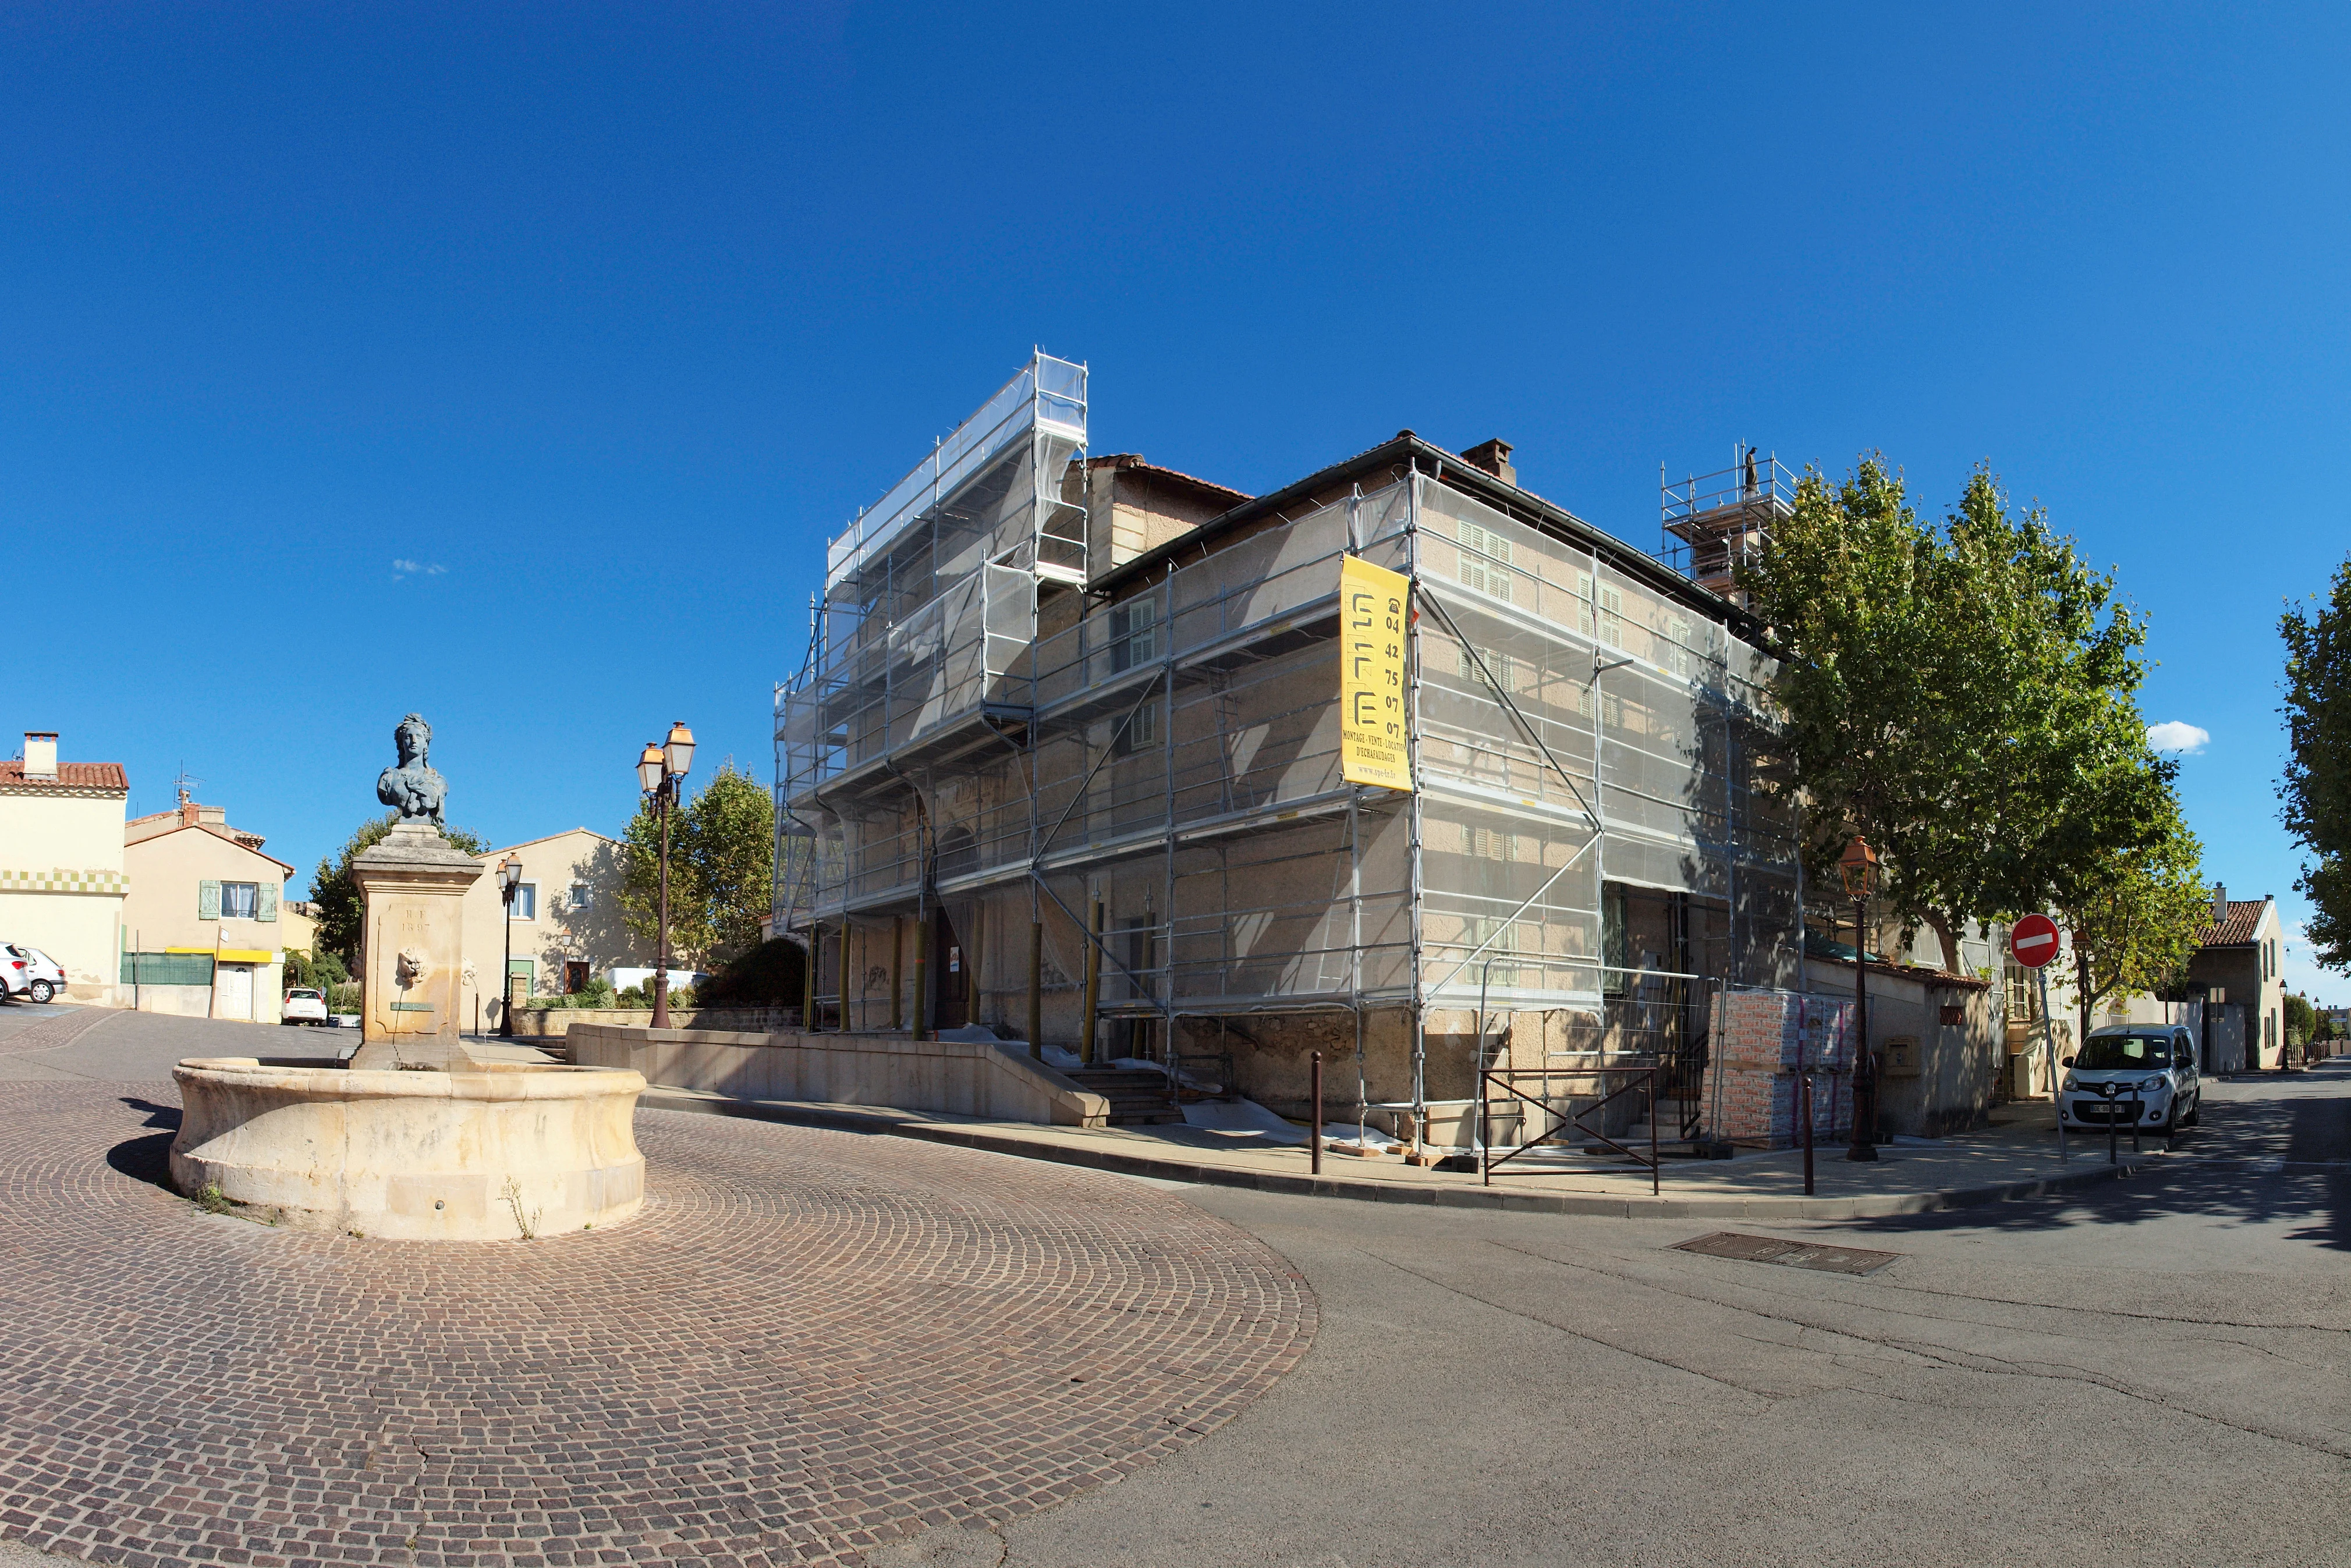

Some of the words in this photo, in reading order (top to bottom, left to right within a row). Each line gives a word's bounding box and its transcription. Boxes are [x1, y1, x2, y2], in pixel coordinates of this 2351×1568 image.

[1386, 616, 1399, 634] 04
[1385, 643, 1399, 659] 42
[1385, 669, 1398, 686] 75
[1385, 696, 1398, 713] 07
[1387, 722, 1399, 739] 07
[1343, 730, 1365, 743] MONTAGE
[1368, 735, 1382, 747] VENTE
[1385, 739, 1406, 753] LOCATION
[402, 923, 430, 931] 1897
